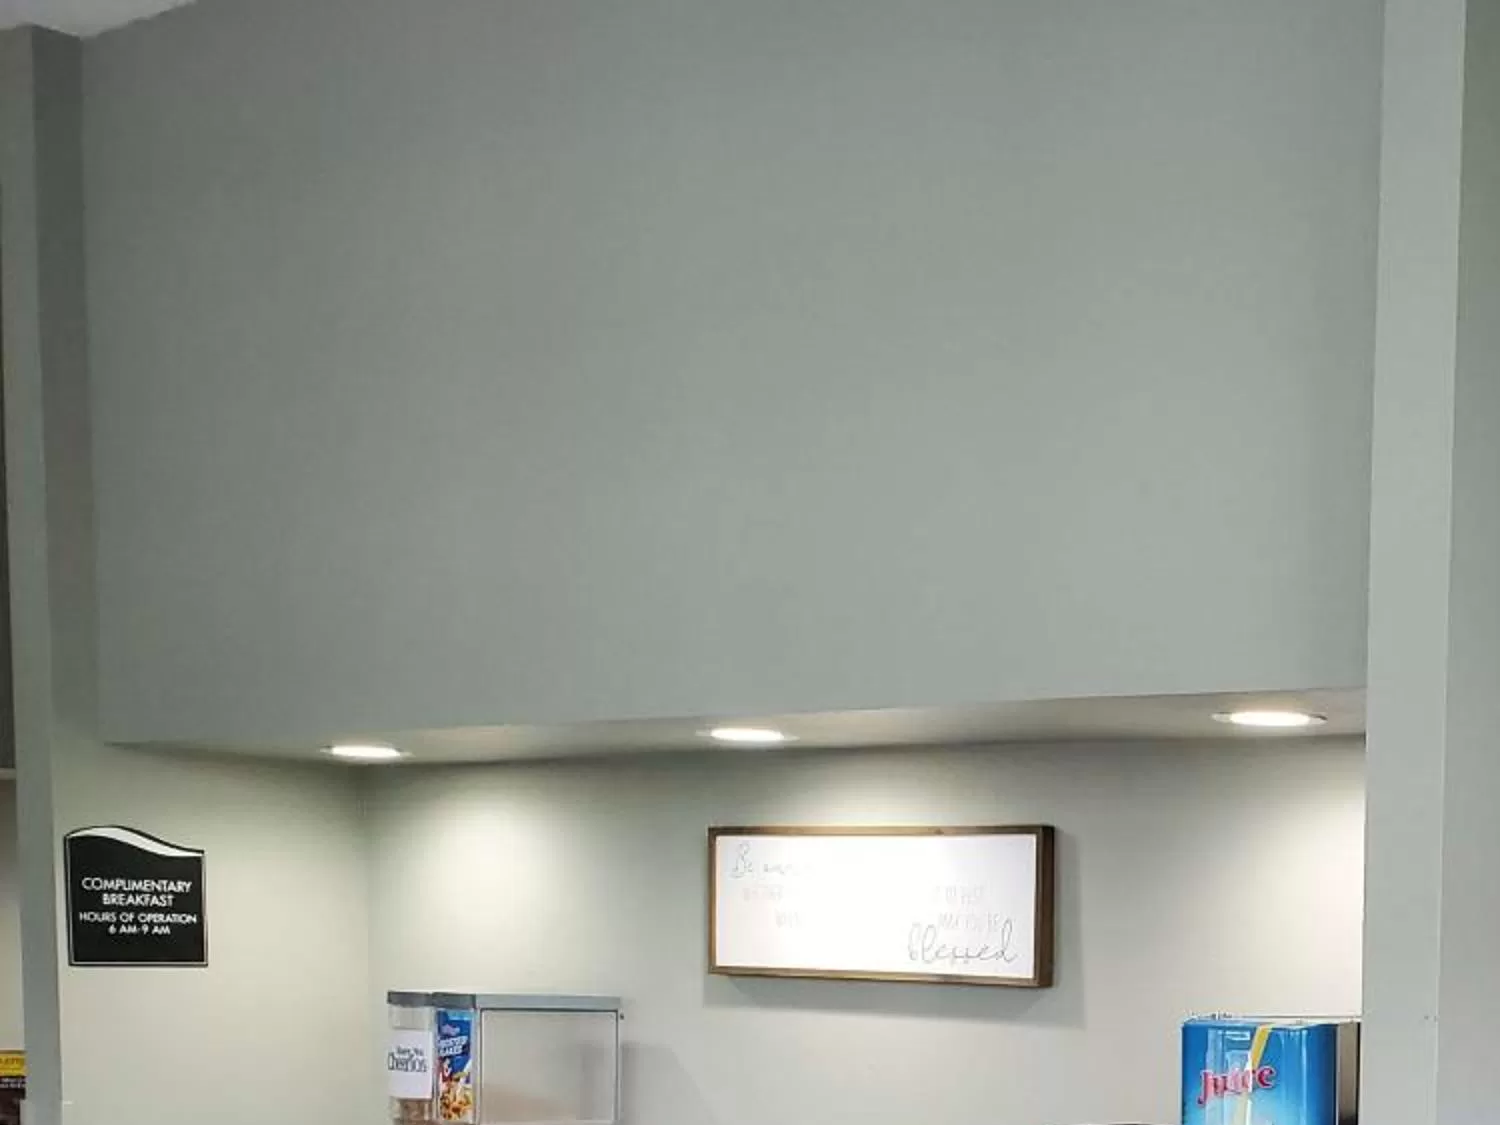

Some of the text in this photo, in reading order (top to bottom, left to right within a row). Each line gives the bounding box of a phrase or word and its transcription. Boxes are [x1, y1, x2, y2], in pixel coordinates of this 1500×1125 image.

[81, 877, 192, 893] COMPLIMENTARY
[102, 893, 174, 907] BREAKFAST
[79, 911, 198, 924] HOURS OF OPERATION
[108, 924, 117, 934] 6
[151, 925, 171, 935] AM
[908, 917, 1020, 966] blessed
[1196, 1065, 1277, 1107] Juice
